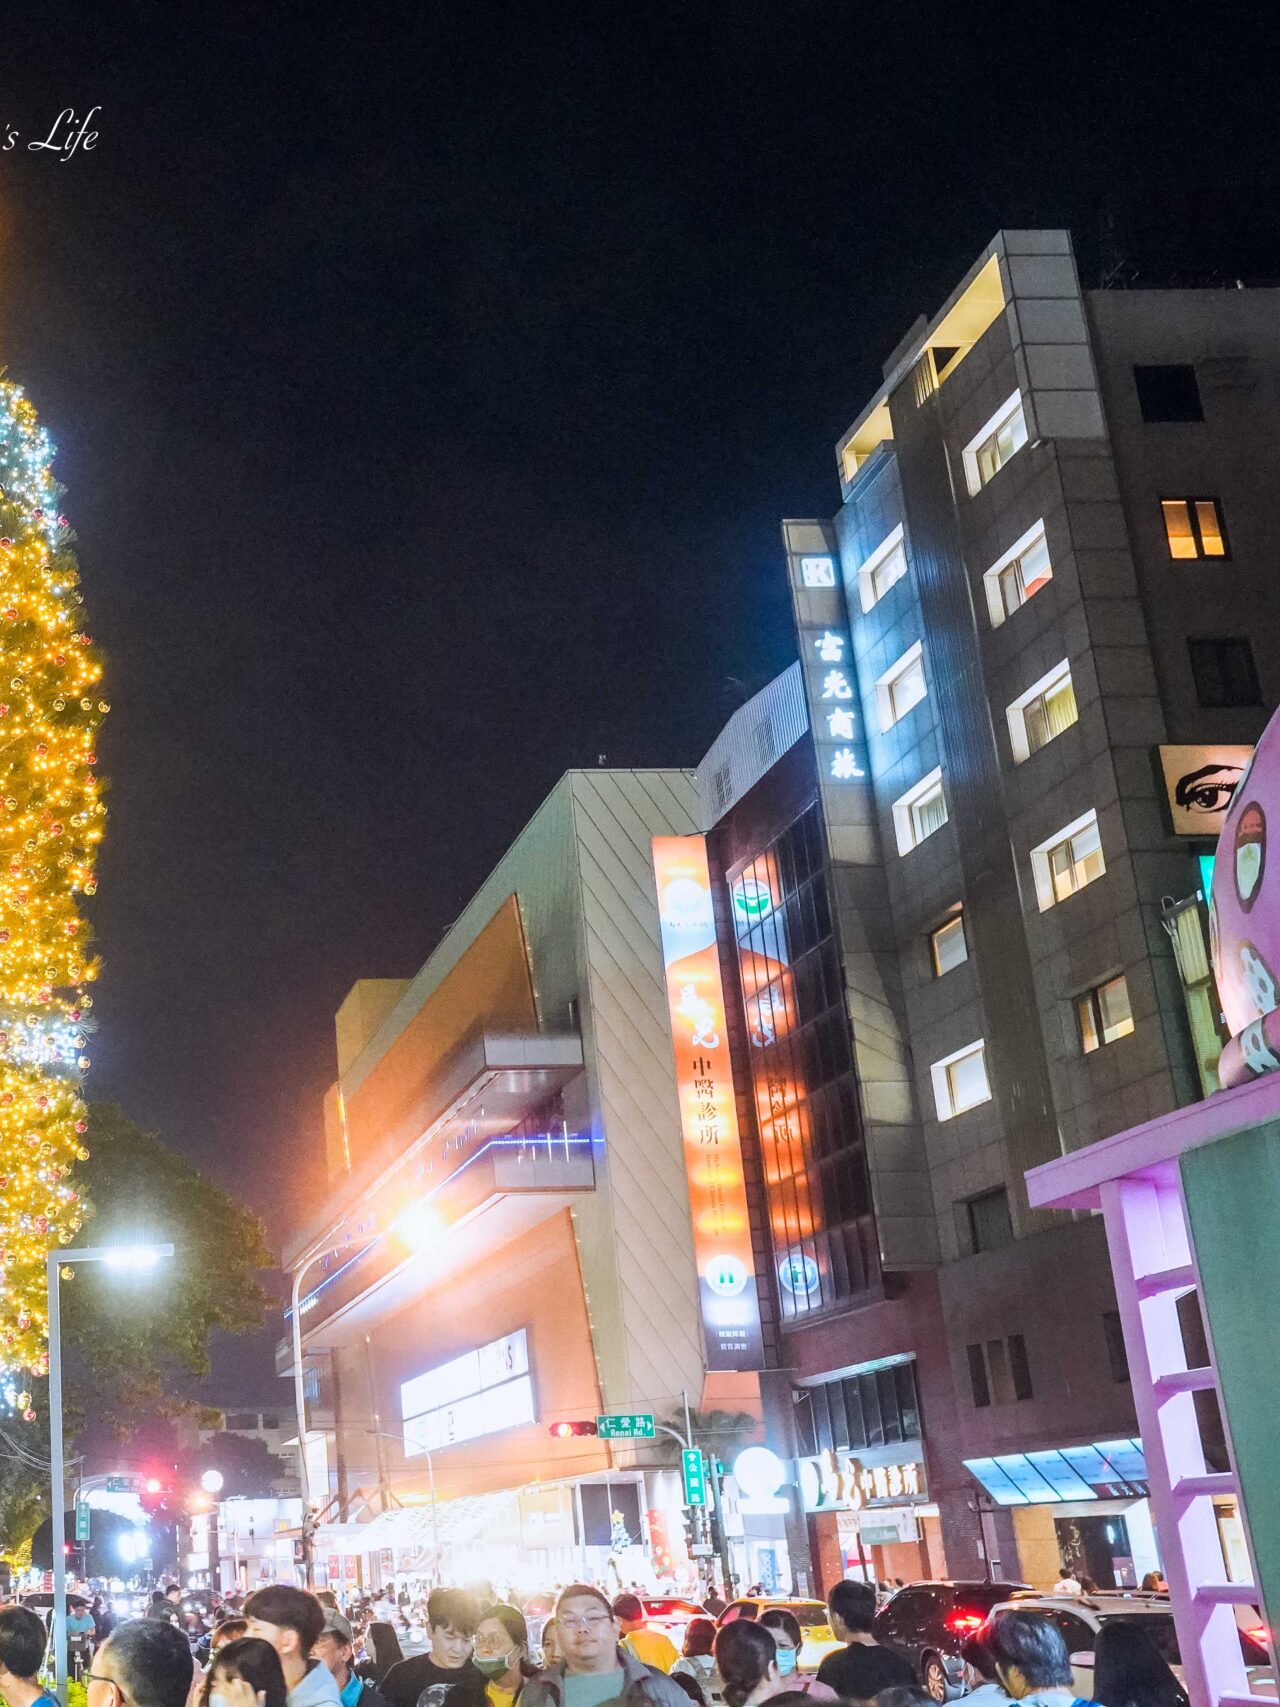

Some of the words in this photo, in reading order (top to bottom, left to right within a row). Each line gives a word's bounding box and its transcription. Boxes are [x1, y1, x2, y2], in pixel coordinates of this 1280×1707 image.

[692, 1056, 719, 1145] 中醫診所
[605, 1417, 646, 1428] 仁愛路
[610, 1429, 632, 1437] Renai
[633, 1428, 646, 1436] Rd.
[688, 1462, 701, 1503] 公園路
[860, 1462, 919, 1500] 中醫診所
